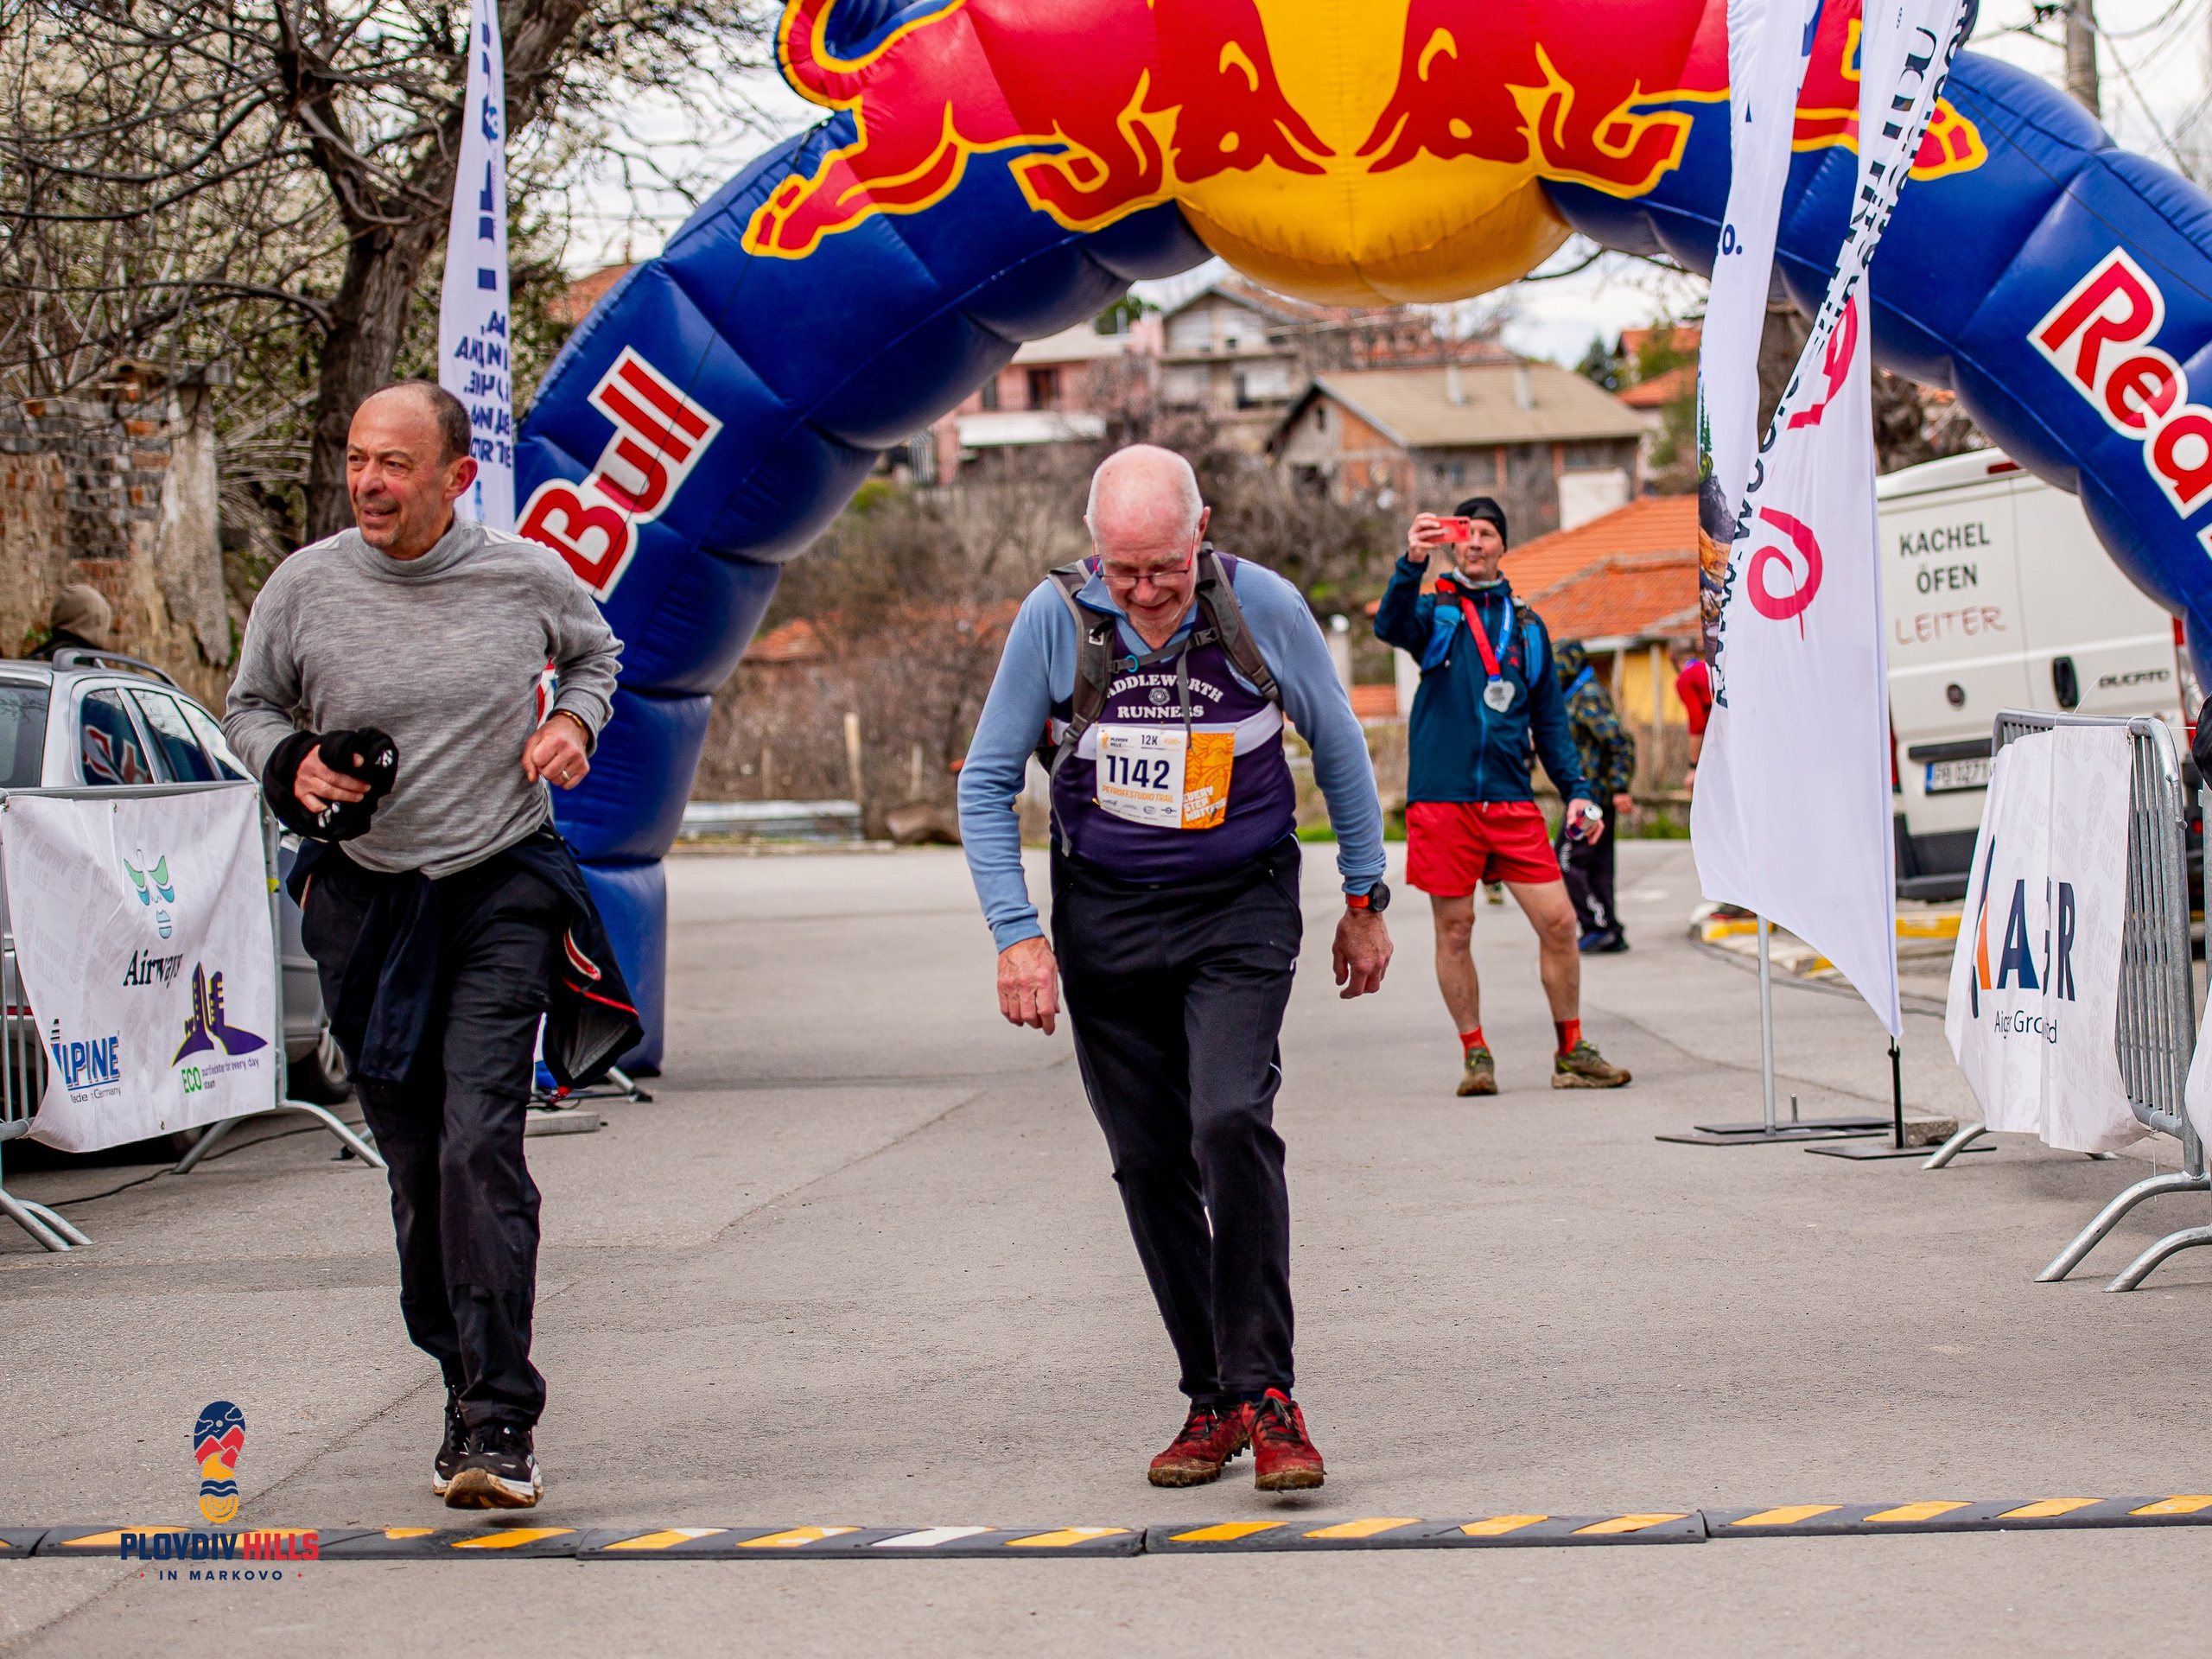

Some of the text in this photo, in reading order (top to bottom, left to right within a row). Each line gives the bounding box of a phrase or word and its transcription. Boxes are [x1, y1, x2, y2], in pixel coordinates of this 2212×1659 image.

[518, 353, 715, 594] Bull
[1899, 521, 1992, 557] KACHEL
[1915, 563, 1978, 594] ÖFEN
[1894, 605, 2008, 646] LEITER
[1107, 674, 1224, 703] ADDLEWRTH
[1141, 734, 1158, 746] 12K
[1106, 754, 1170, 790] 1142
[1155, 793, 1174, 804] TRAIL
[1183, 797, 1209, 813] STEP
[247, 1058, 259, 1069] day
[181, 1066, 202, 1094] ECO
